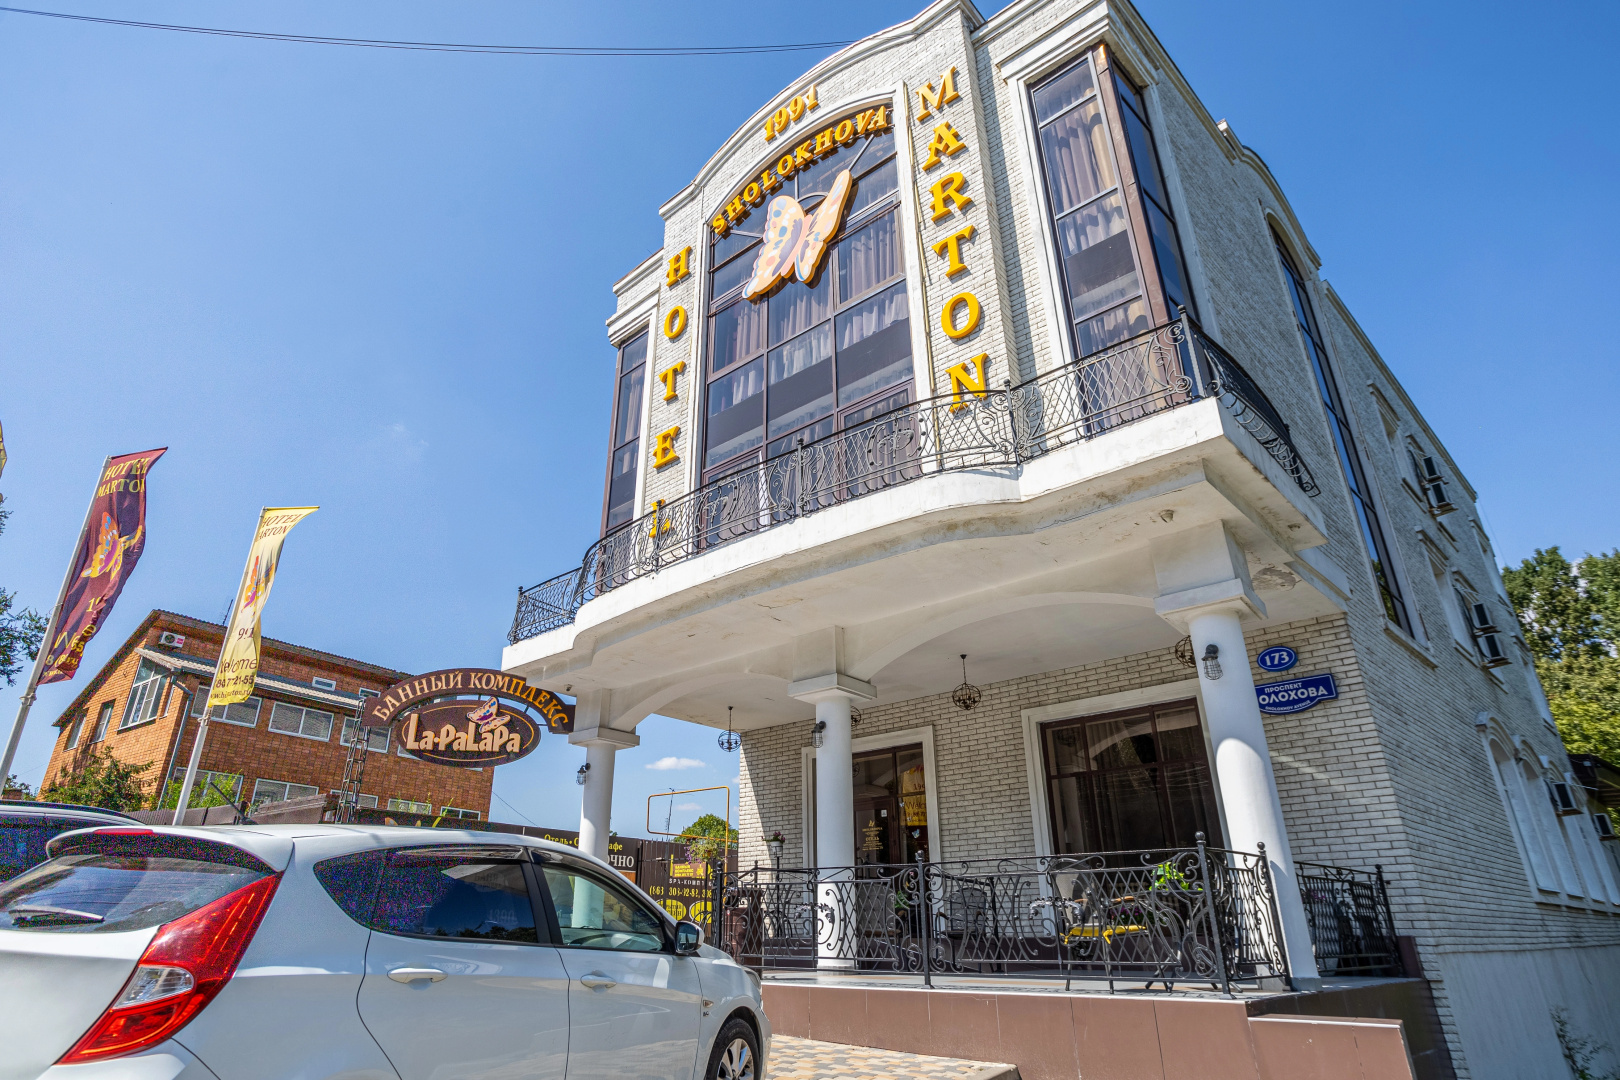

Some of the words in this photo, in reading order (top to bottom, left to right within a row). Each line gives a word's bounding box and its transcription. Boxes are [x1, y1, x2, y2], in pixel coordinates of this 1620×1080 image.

[764, 84, 818, 142] 1991
[711, 105, 889, 235] SHOLOKHOVA
[915, 65, 990, 414] MARTON
[648, 246, 692, 538] HOTEL
[102, 457, 150, 482] HOTEL
[1264, 651, 1290, 666] 173
[372, 670, 464, 722] БАННЫЙ
[469, 672, 569, 728] КОМПЛЕКС
[1258, 685, 1329, 705] ОЛОХОВА
[1264, 682, 1303, 694] ПРОСПЕКТ
